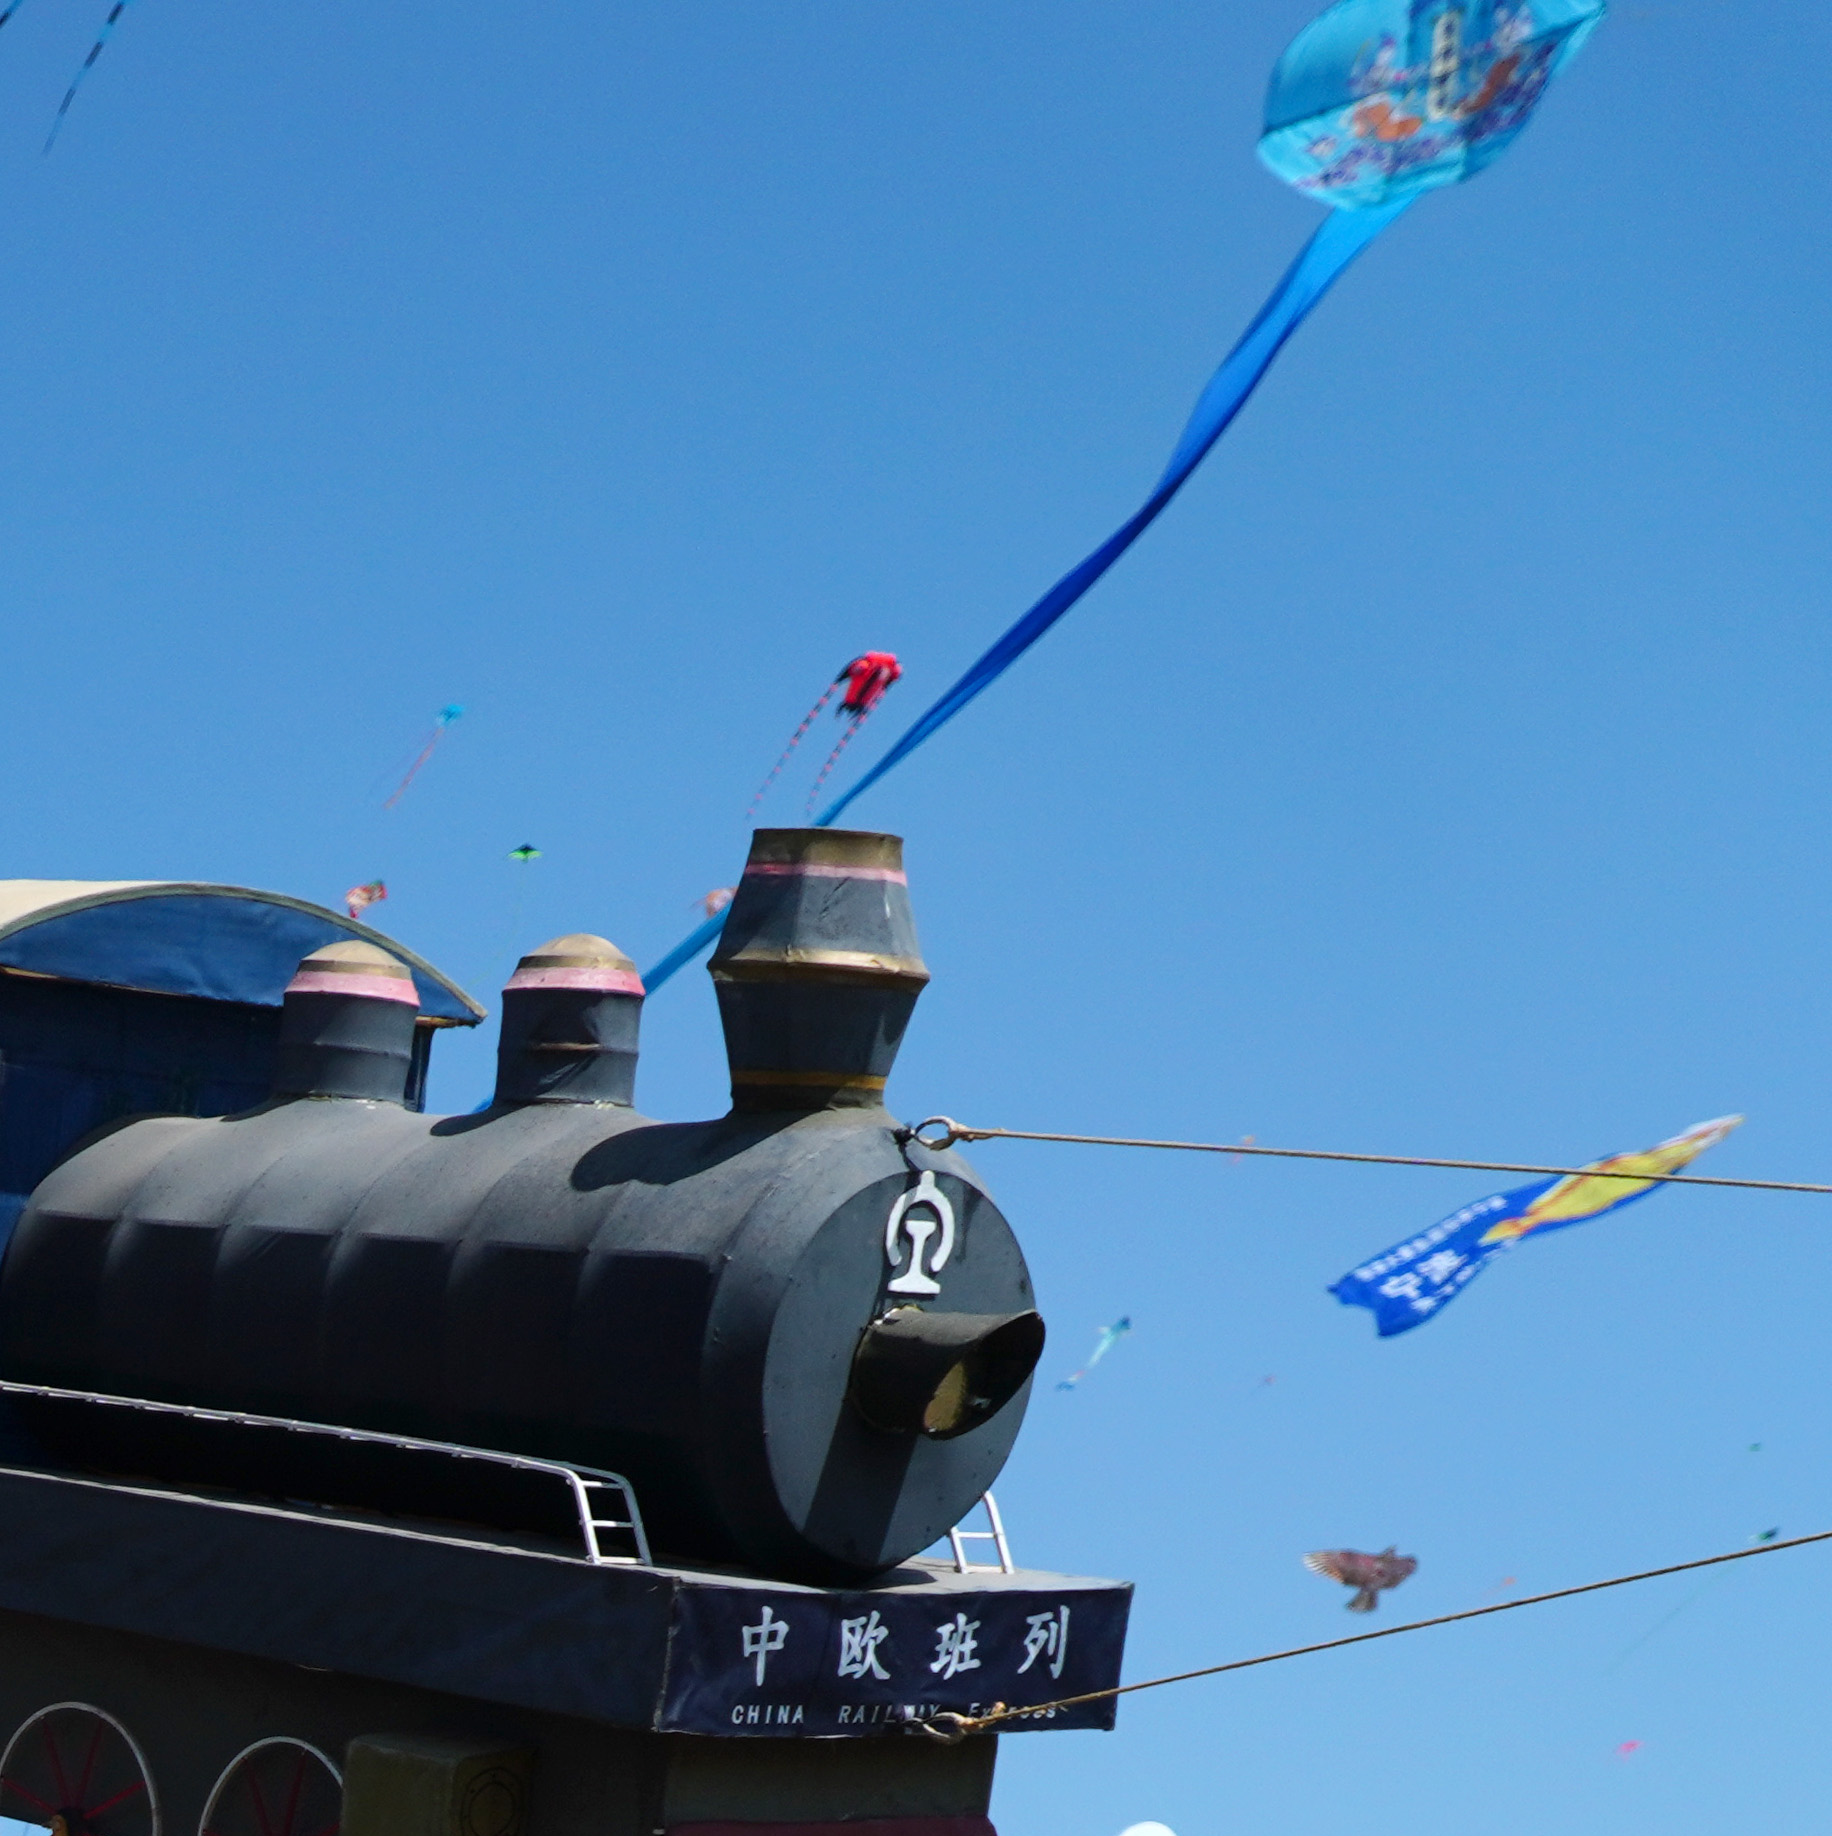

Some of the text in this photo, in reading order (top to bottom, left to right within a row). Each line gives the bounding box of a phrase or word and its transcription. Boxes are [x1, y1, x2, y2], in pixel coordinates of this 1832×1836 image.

[741, 1605, 1071, 1687] 中欧班列
[731, 1704, 805, 1724] CHINA
